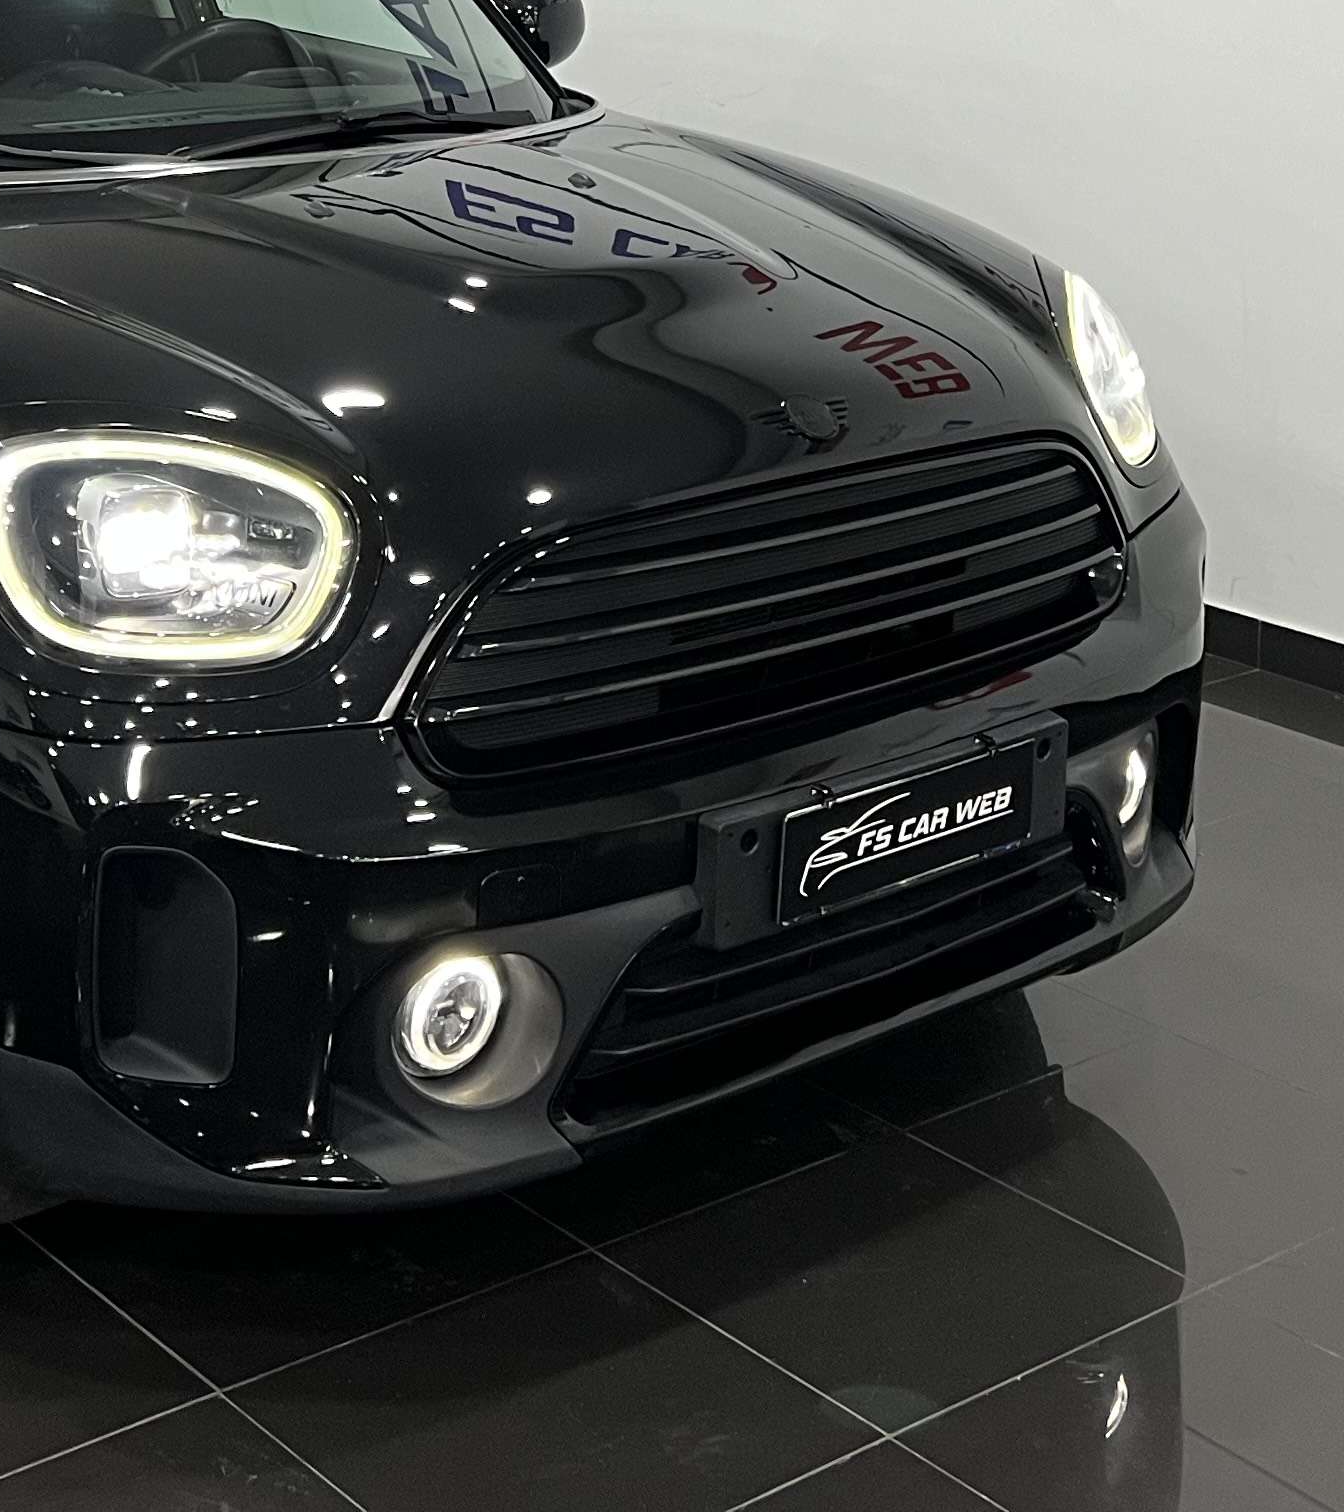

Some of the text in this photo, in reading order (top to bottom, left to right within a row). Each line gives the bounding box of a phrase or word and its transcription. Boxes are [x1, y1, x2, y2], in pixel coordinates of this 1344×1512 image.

[856, 786, 1013, 857] FS CAR WEB
